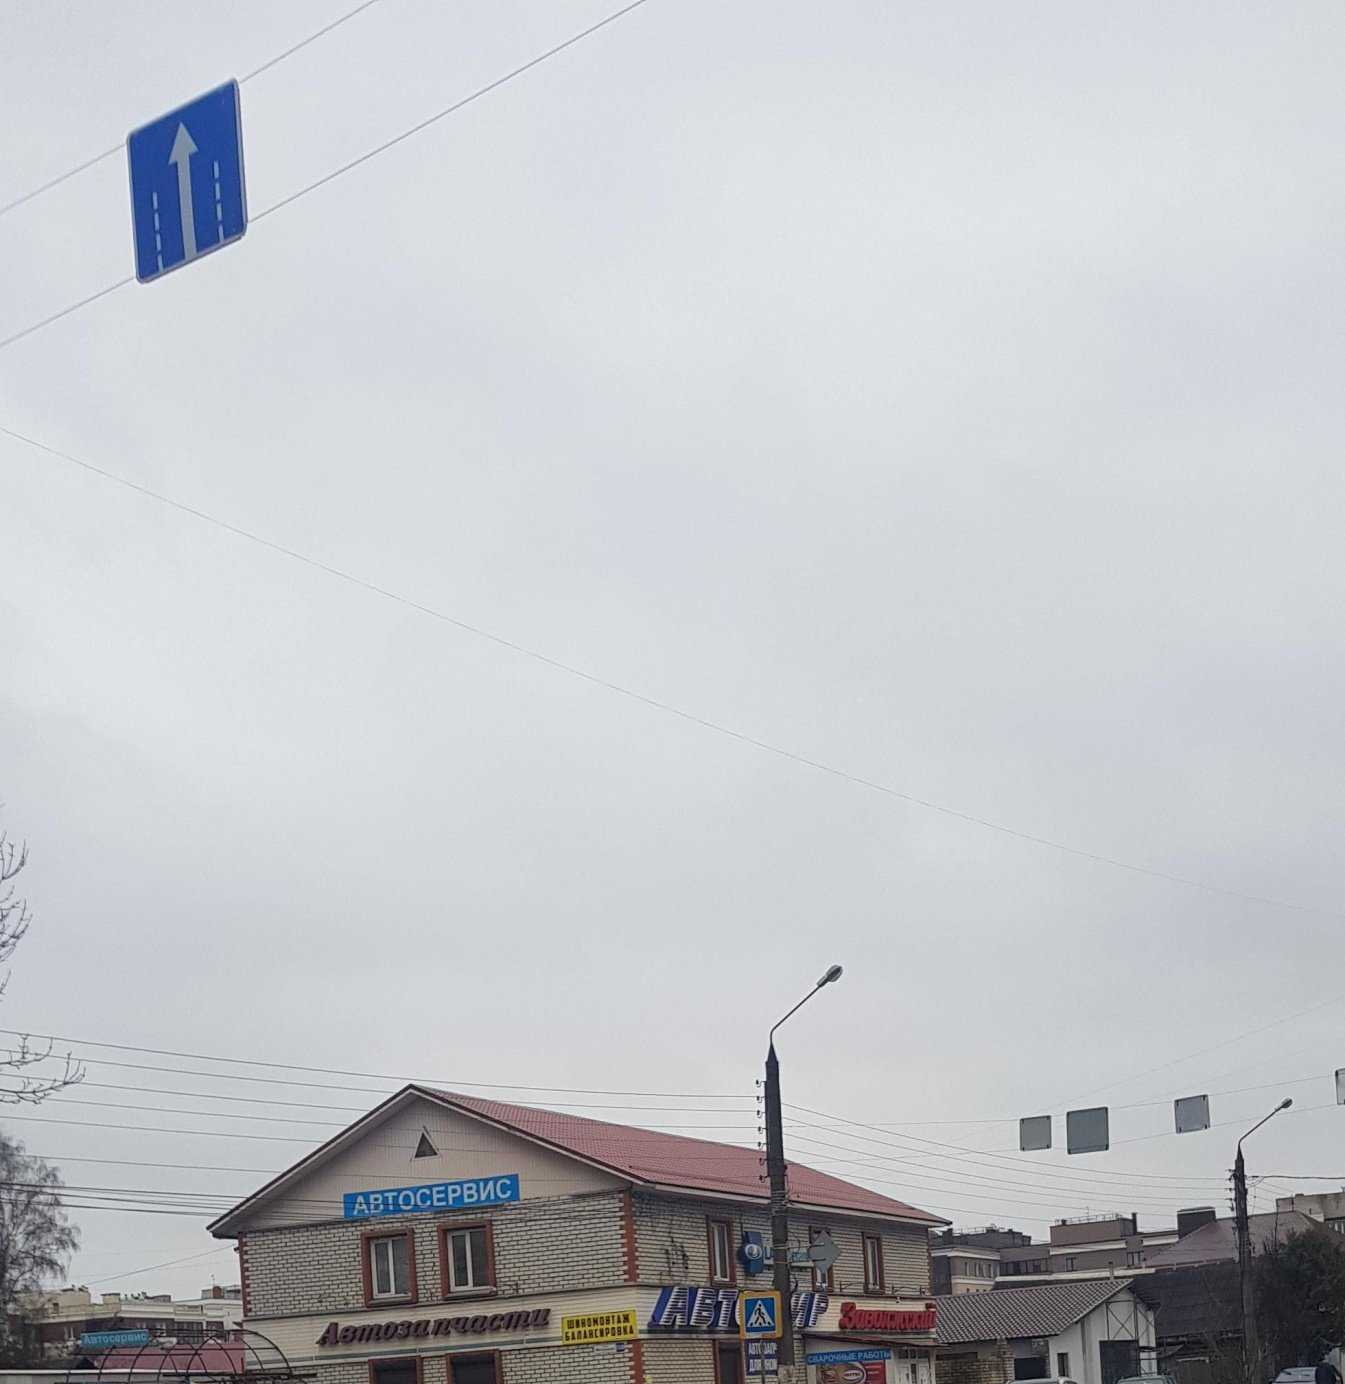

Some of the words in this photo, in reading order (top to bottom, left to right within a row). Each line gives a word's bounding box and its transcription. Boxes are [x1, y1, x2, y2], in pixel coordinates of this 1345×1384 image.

[353, 1179, 512, 1216] АВТОСЕРВИС
[316, 1308, 551, 1346] Автозапчасти
[567, 1313, 630, 1330] ШИНОМОНТАЖ
[564, 1325, 635, 1342] БАЛАНСИРОВКА
[808, 1352, 857, 1363] СВАРОЧНЫЕ
